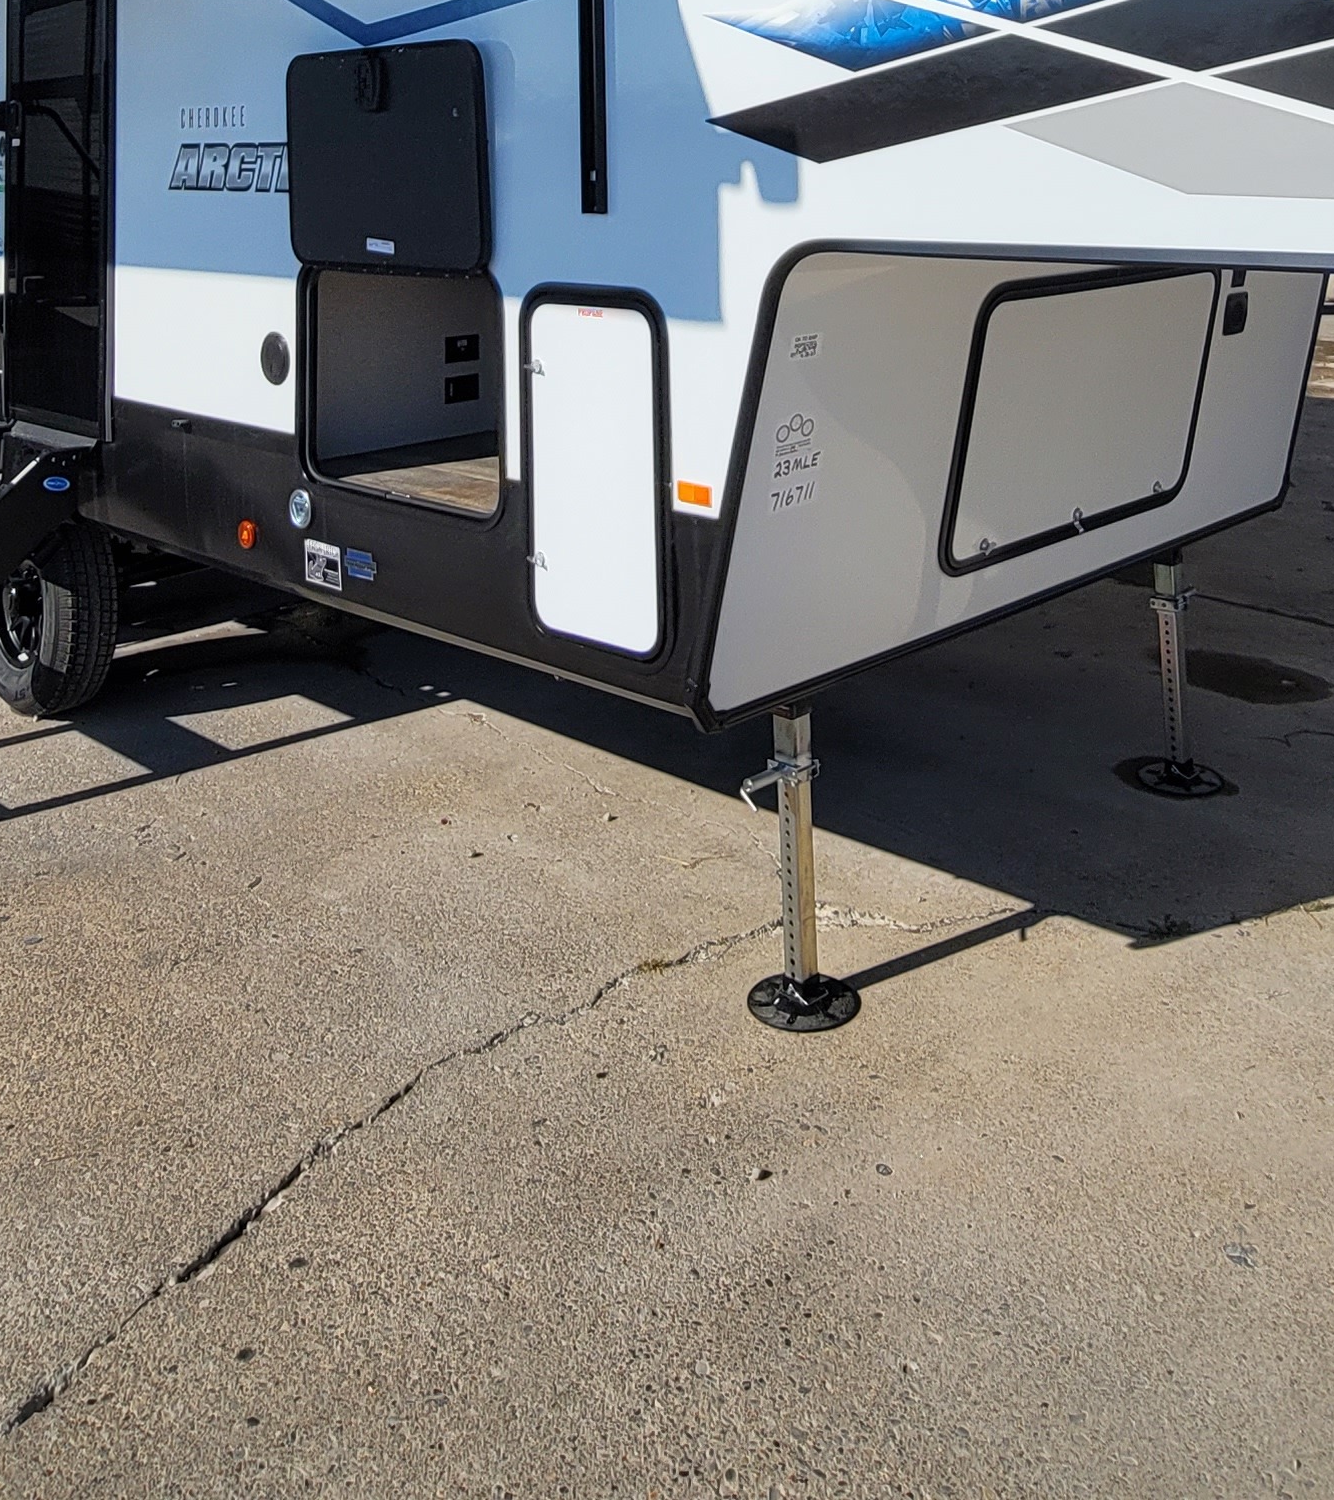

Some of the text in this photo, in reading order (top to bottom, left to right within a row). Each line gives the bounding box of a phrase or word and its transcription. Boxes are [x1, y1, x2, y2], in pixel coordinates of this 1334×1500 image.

[180, 104, 246, 129] CHEROKEE
[773, 450, 821, 479] 23MLE
[770, 481, 816, 512] 716711
